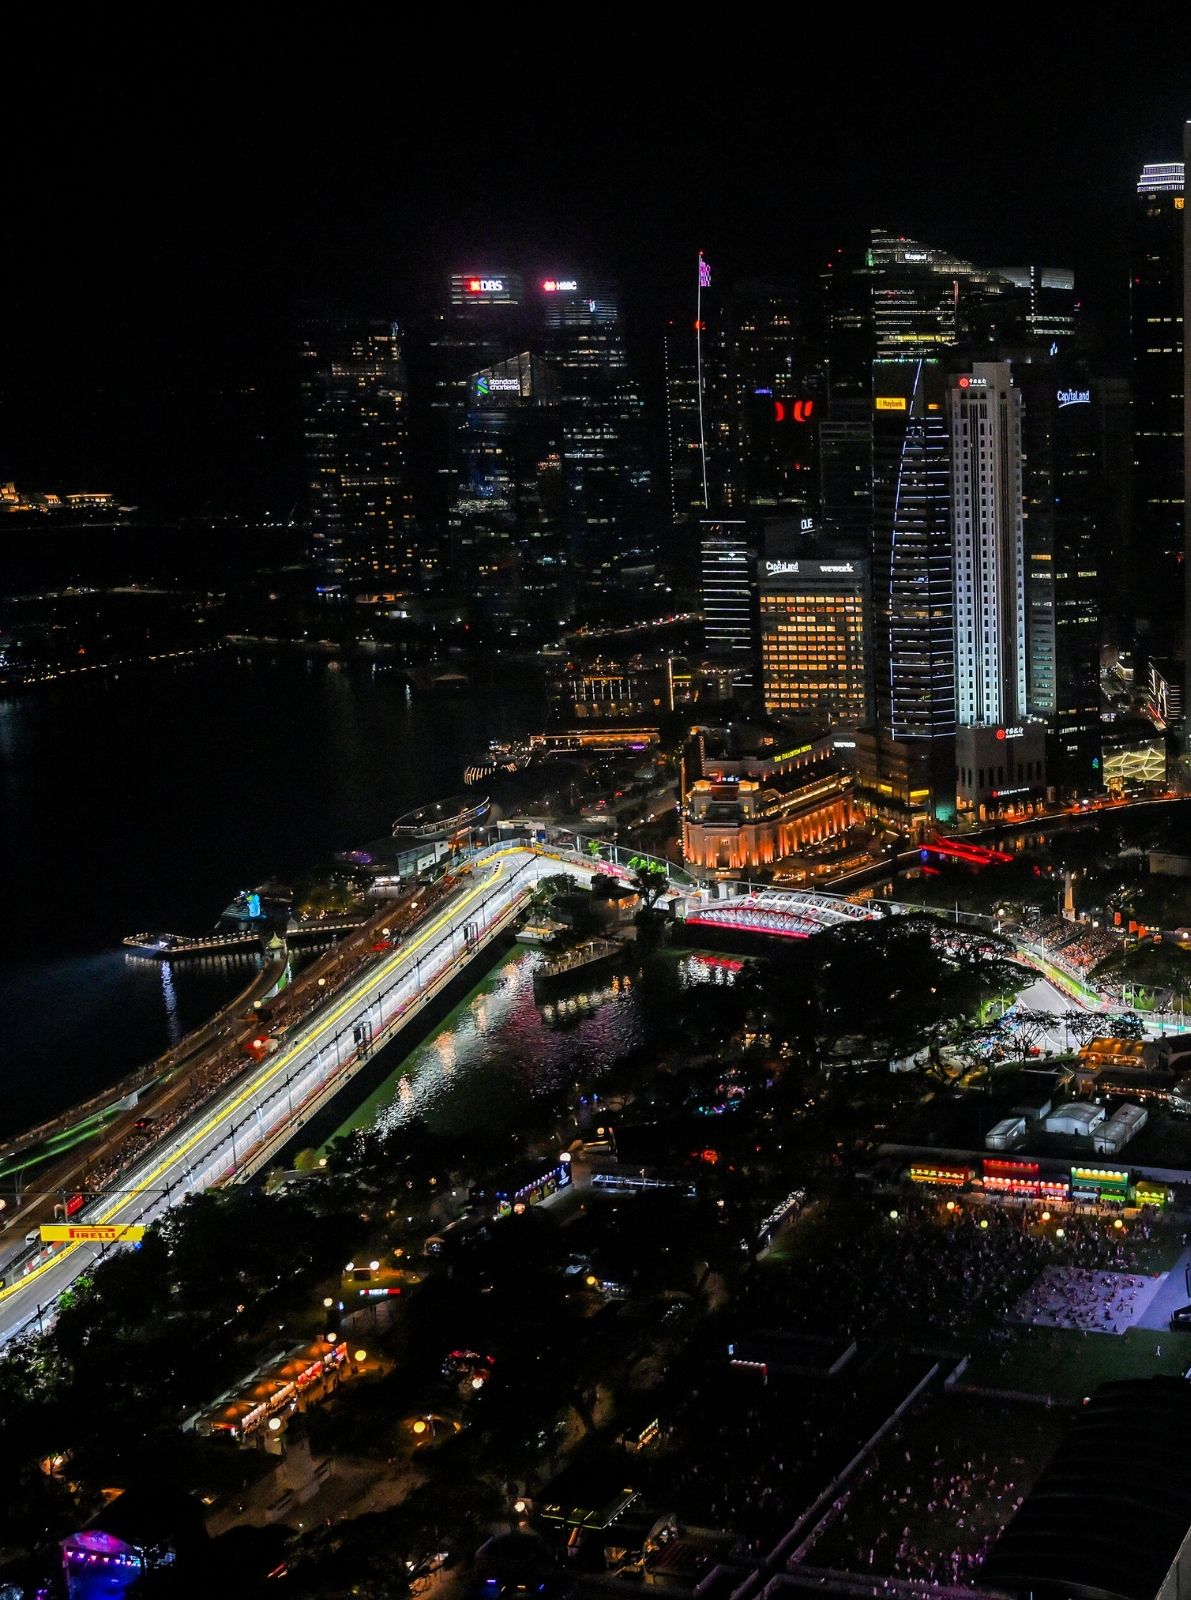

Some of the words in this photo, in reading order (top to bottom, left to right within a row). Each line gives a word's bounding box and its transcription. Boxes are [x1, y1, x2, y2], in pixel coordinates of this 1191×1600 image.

[480, 280, 503, 291] DBS
[1057, 389, 1090, 404] CapitaLand
[883, 399, 904, 409] Maybank
[801, 518, 814, 530] OUE
[766, 560, 799, 573] CapitaLand
[819, 562, 854, 573] wework
[69, 1228, 116, 1239] PIRELLI
